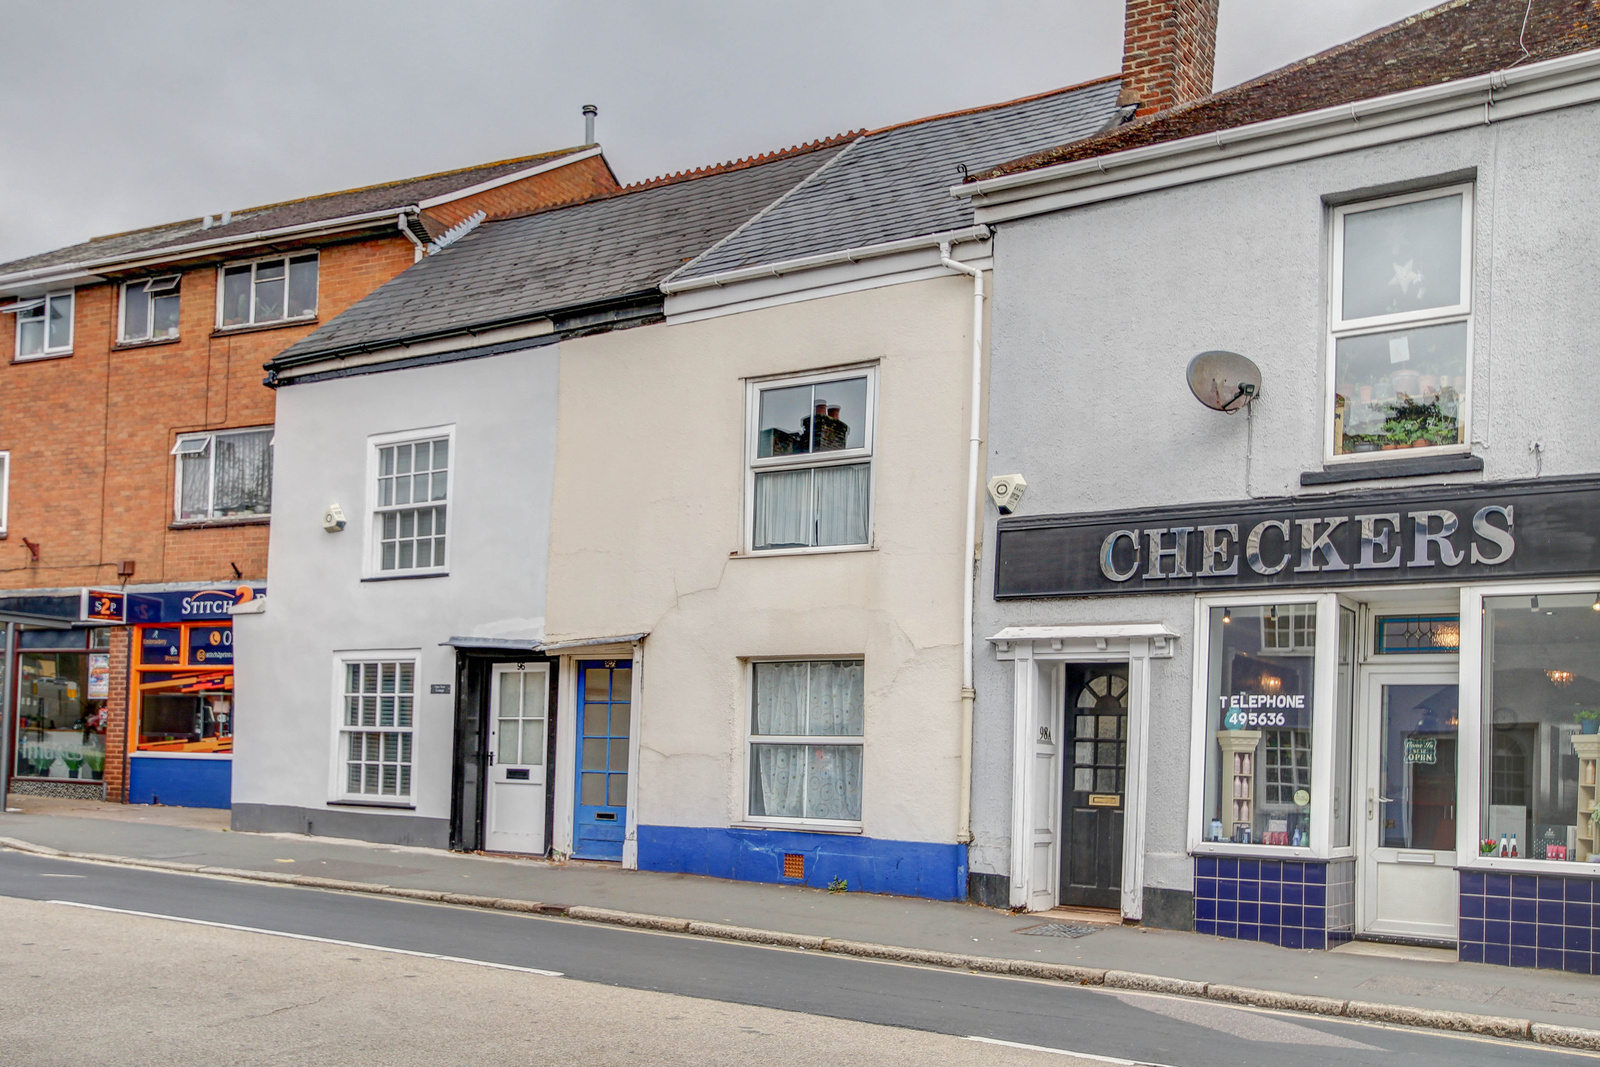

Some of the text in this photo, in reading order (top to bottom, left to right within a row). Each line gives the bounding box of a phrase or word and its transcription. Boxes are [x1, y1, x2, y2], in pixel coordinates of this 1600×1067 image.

[1099, 505, 1516, 582] CHECKERS
[94, 598, 117, 615] S2P
[1219, 695, 1305, 709] TELEPHONE
[1229, 712, 1286, 726] 495636
[1039, 725, 1052, 741] 98A
[1408, 753, 1433, 762] OPEN
